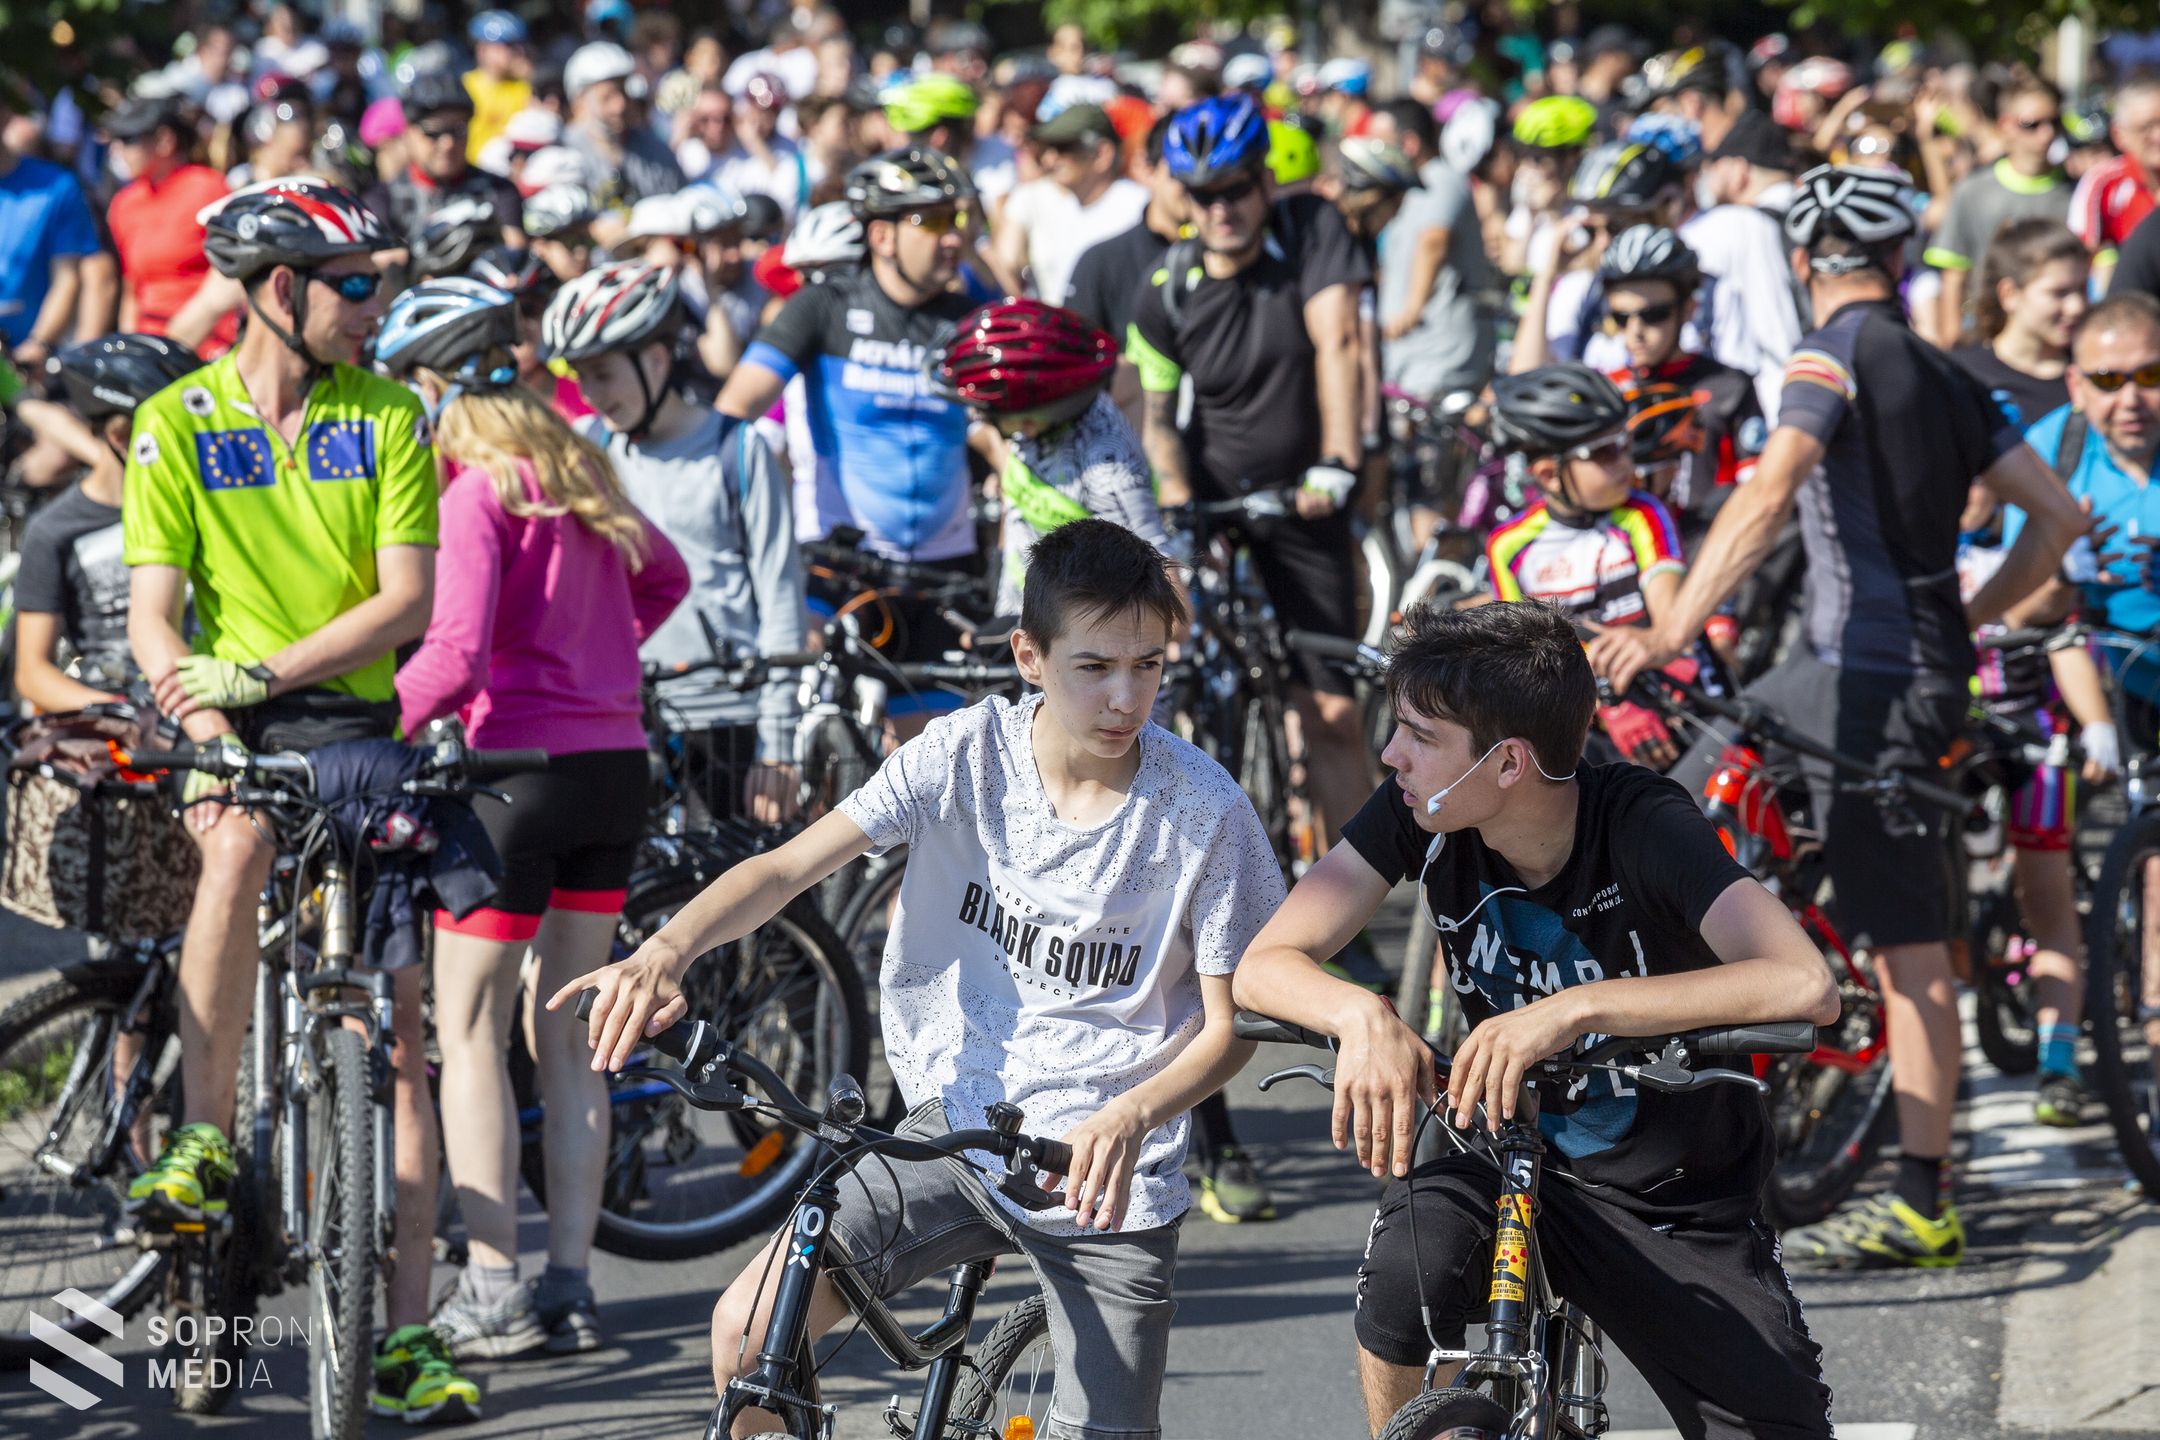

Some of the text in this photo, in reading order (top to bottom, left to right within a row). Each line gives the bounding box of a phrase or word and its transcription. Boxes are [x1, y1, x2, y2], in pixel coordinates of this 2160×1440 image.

[958, 881, 1041, 969] BLACK
[986, 875, 1131, 935] RAISED IN THE
[994, 954, 1079, 1000] PROJECT
[793, 1204, 825, 1237] 10
